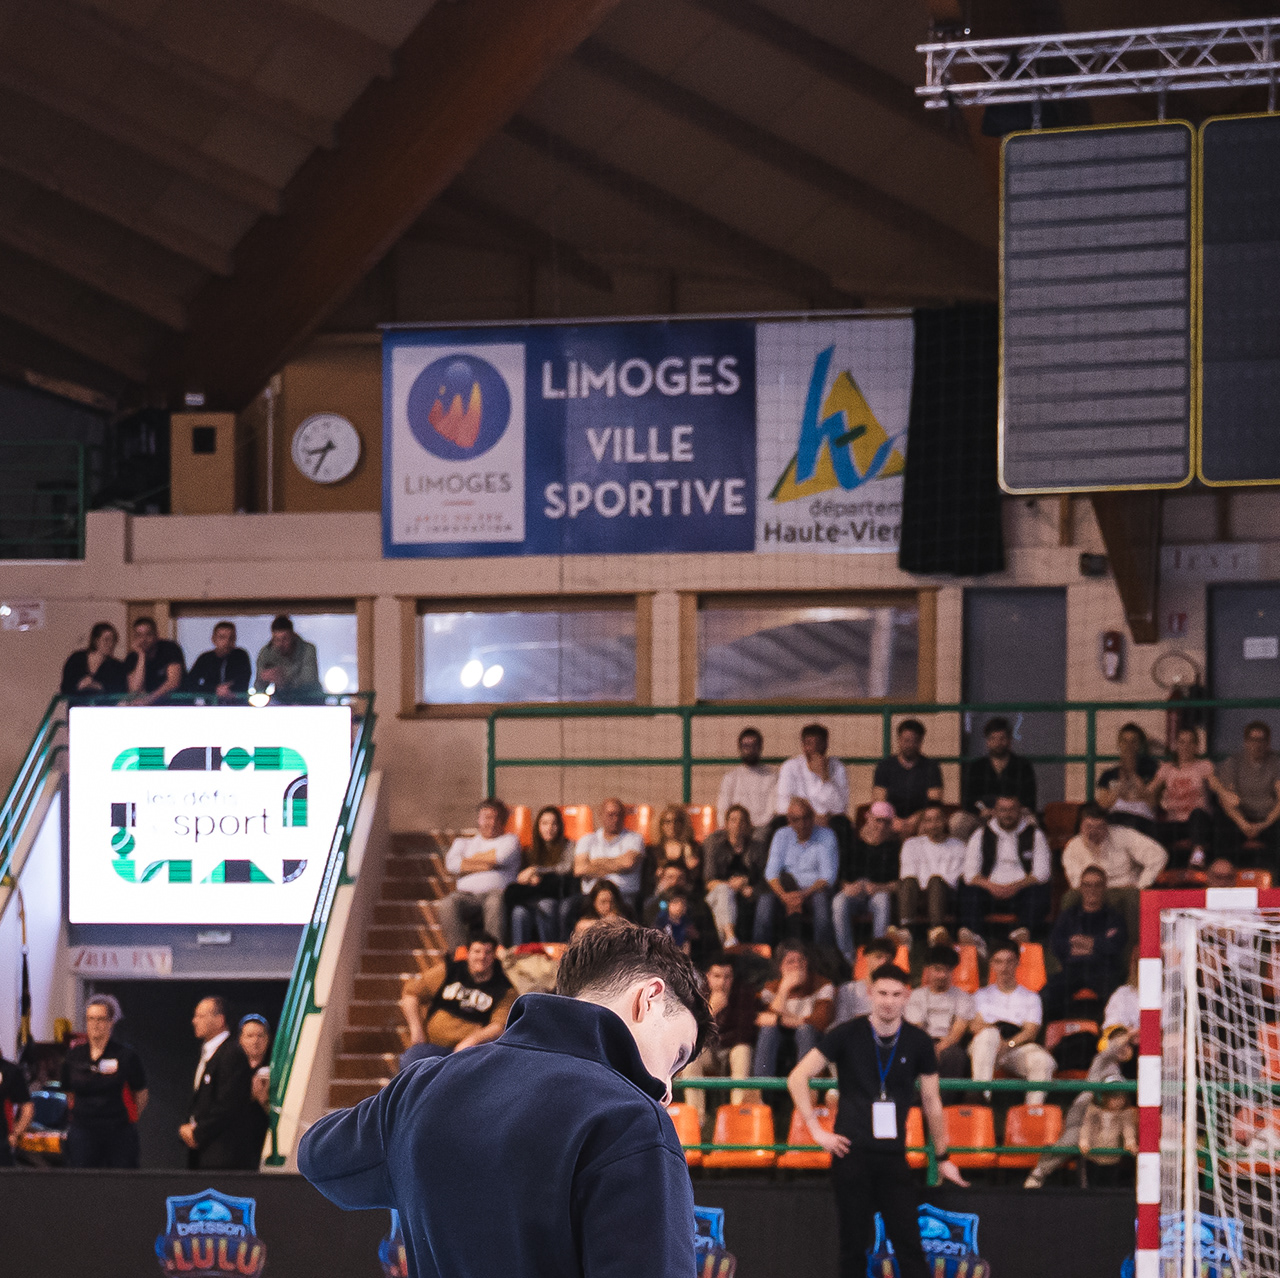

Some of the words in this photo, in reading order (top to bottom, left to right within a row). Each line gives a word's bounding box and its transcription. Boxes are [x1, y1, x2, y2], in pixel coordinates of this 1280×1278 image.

[542, 356, 741, 399] LIMOGES
[586, 424, 695, 463] VILLE
[404, 471, 512, 495] LIMOGES
[544, 478, 747, 519] SPORTIVE
[174, 808, 271, 843] sport
[173, 1237, 261, 1275] LULU
